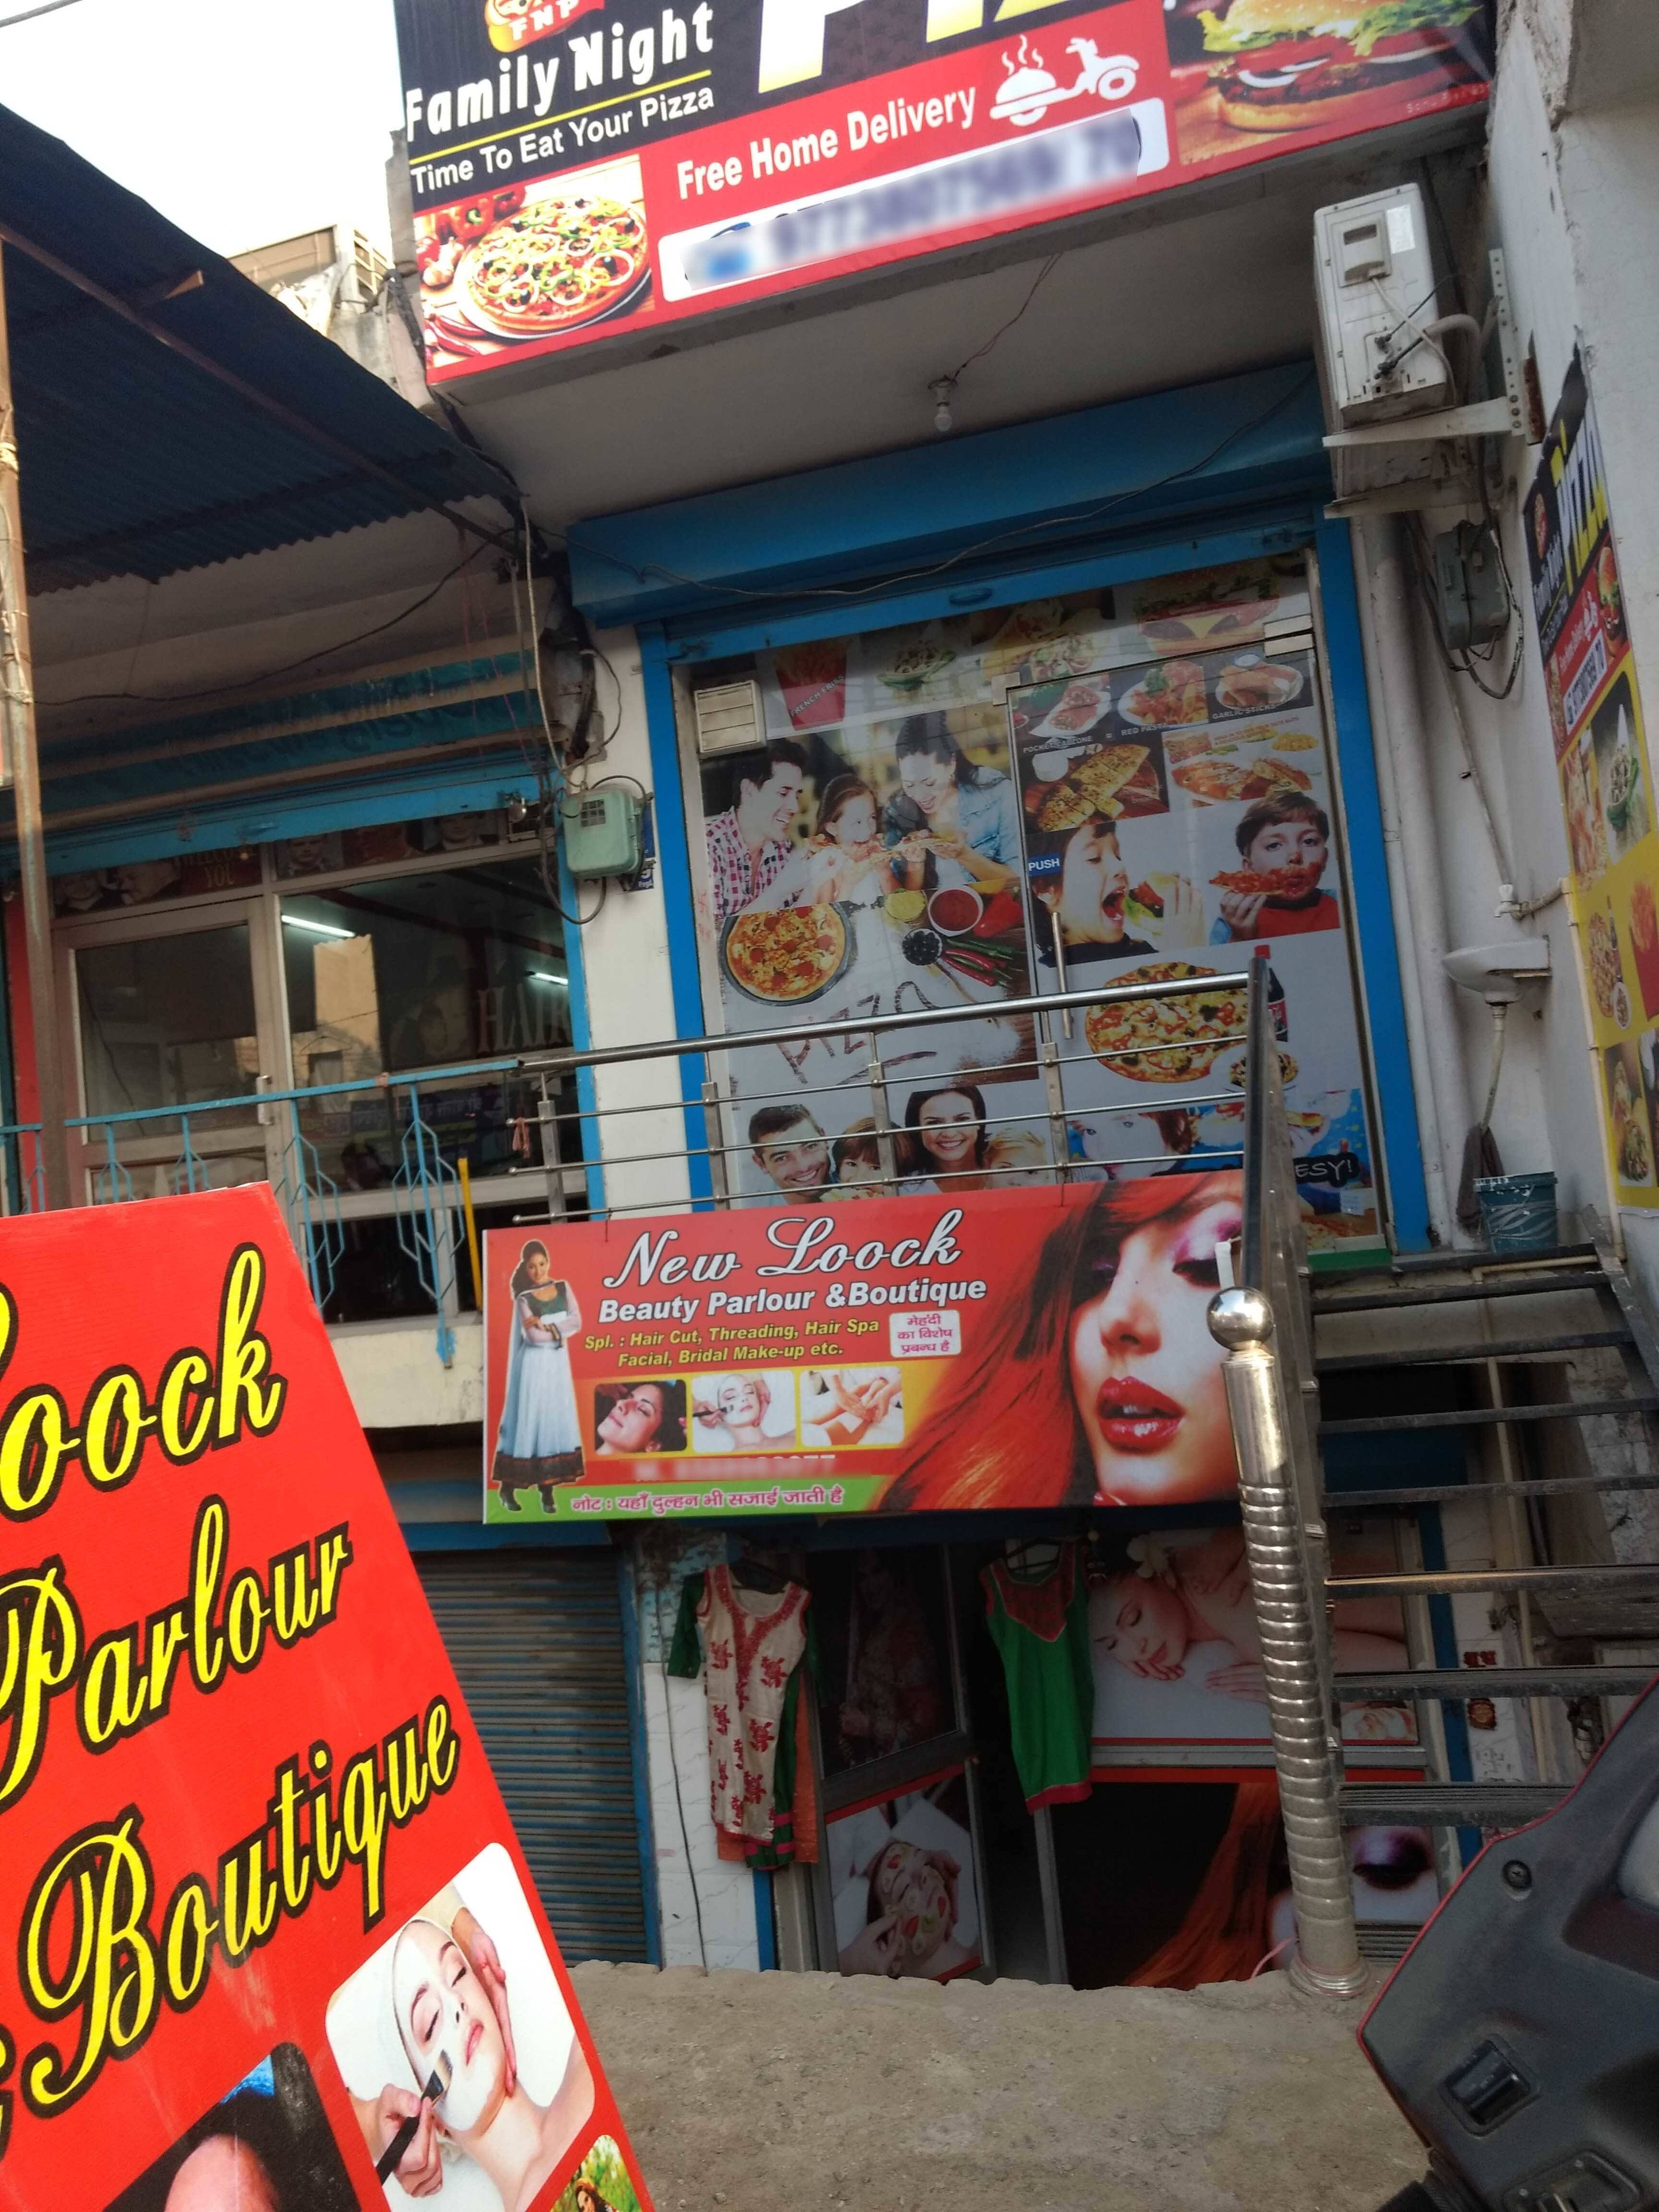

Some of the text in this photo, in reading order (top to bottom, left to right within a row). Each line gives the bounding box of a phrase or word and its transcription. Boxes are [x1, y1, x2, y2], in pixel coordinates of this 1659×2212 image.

[509, 0, 578, 41] FNP
[407, 54, 560, 142] Family
[568, 1, 714, 91] Night
[410, 86, 714, 194] Time To Eat Your Pizza
[677, 86, 976, 200] Free Home Delivery
[790, 691, 821, 717] FRENCH
[1121, 725, 1138, 736] RED
[1028, 858, 1060, 871] PUSH
[1295, 1159, 1352, 1181] ESY!
[602, 1208, 964, 1288] New Loock
[597, 1295, 700, 1324] Beauty
[707, 1288, 816, 1316] Parlour
[629, 1332, 665, 1346] Hair
[669, 1329, 702, 1345] Cut,
[709, 1323, 799, 1342] Threading,
[805, 1320, 842, 1335] Hair
[846, 1318, 879, 1335] Spa
[897, 1326, 953, 1339] का विशेष
[940, 1339, 950, 1352] है
[618, 1341, 844, 1368] Facial, Bridal Make-up etc.
[0, 1242, 288, 1523] oock
[572, 1494, 602, 1512] नोट
[615, 1490, 651, 1511] यहाँ
[651, 1494, 700, 1518] दुल्हन
[703, 1488, 725, 1507] भी
[727, 1485, 780, 1507] सजाई
[781, 1484, 825, 1504] जाती
[830, 1483, 845, 1504] है
[0, 1494, 354, 1817] Parlour
[17, 1694, 461, 2119] Boutique
